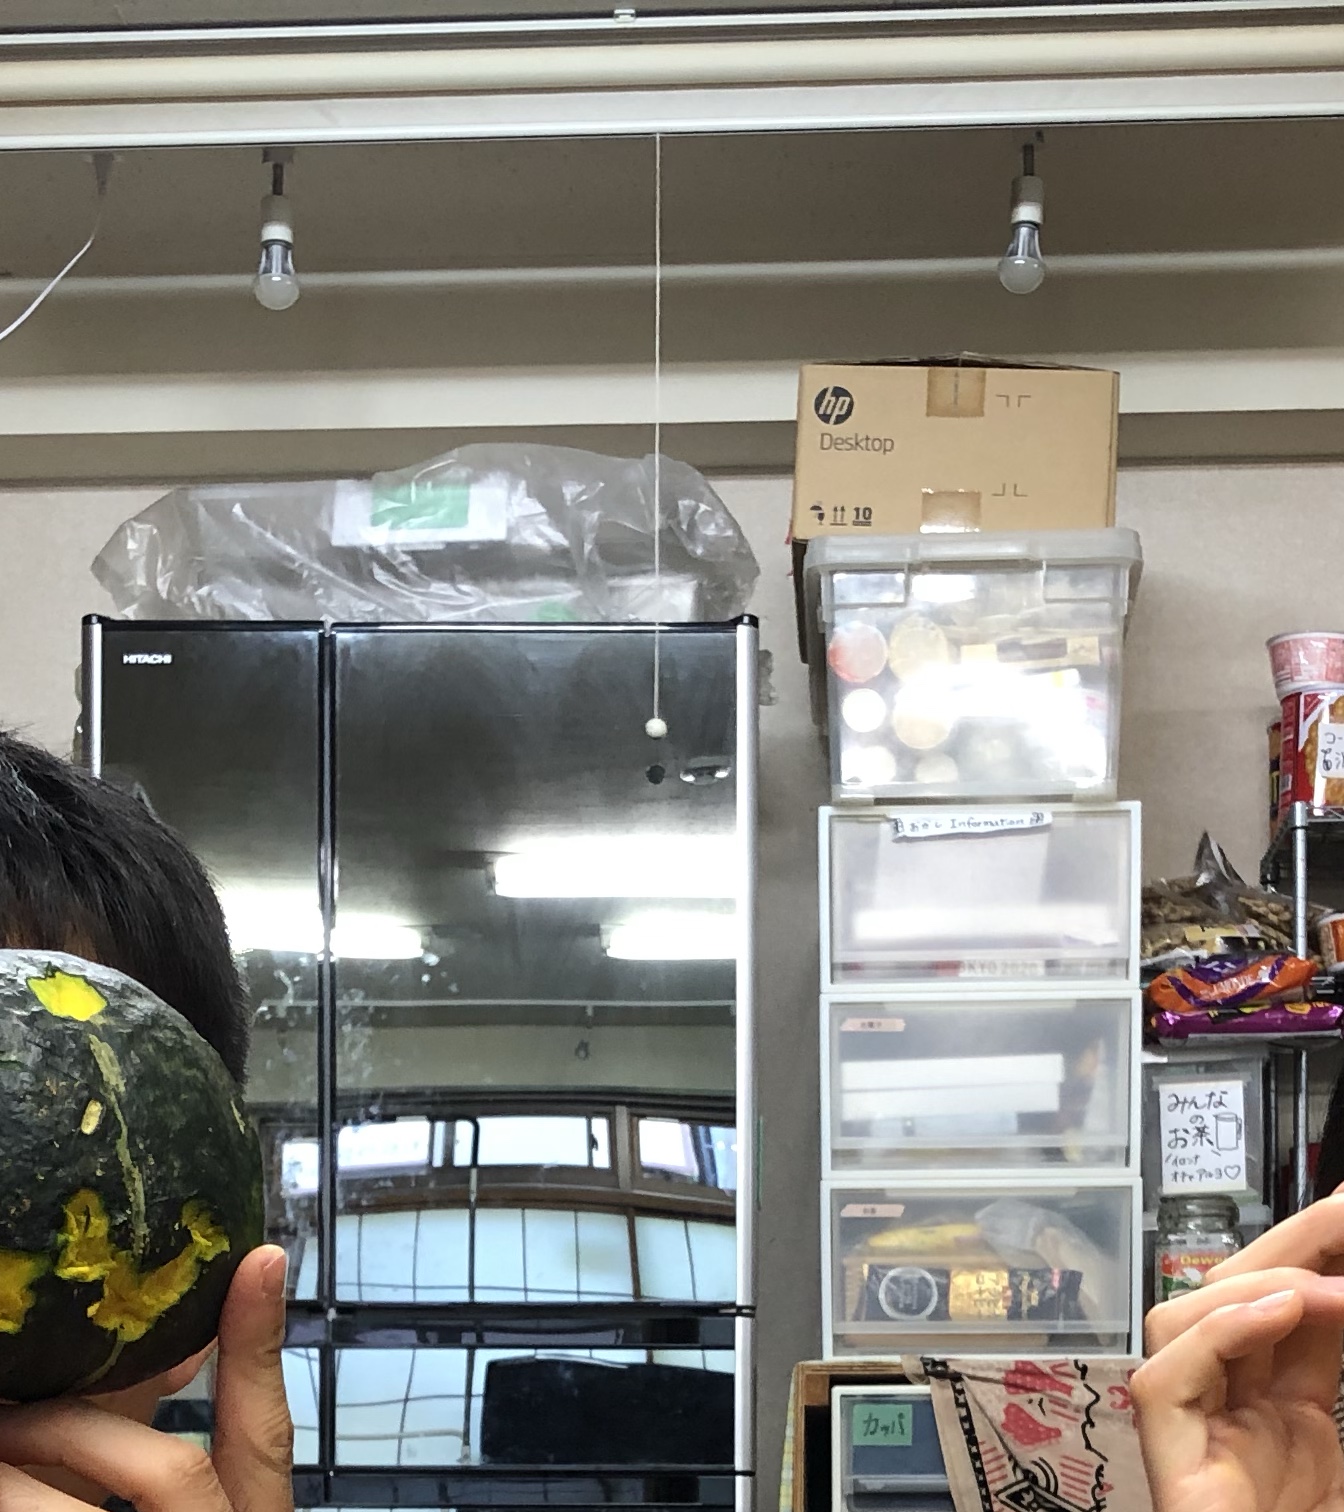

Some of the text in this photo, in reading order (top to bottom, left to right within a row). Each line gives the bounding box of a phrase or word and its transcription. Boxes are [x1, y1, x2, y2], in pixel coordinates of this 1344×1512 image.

[819, 386, 851, 425] hp
[820, 432, 895, 455] Desktop
[853, 507, 873, 520] 10
[123, 654, 172, 664] HITACHI
[1167, 1090, 1229, 1114] みんな
[1189, 1114, 1205, 1125] の
[1167, 1124, 1214, 1149] お茶
[863, 1412, 906, 1438] カッパ
